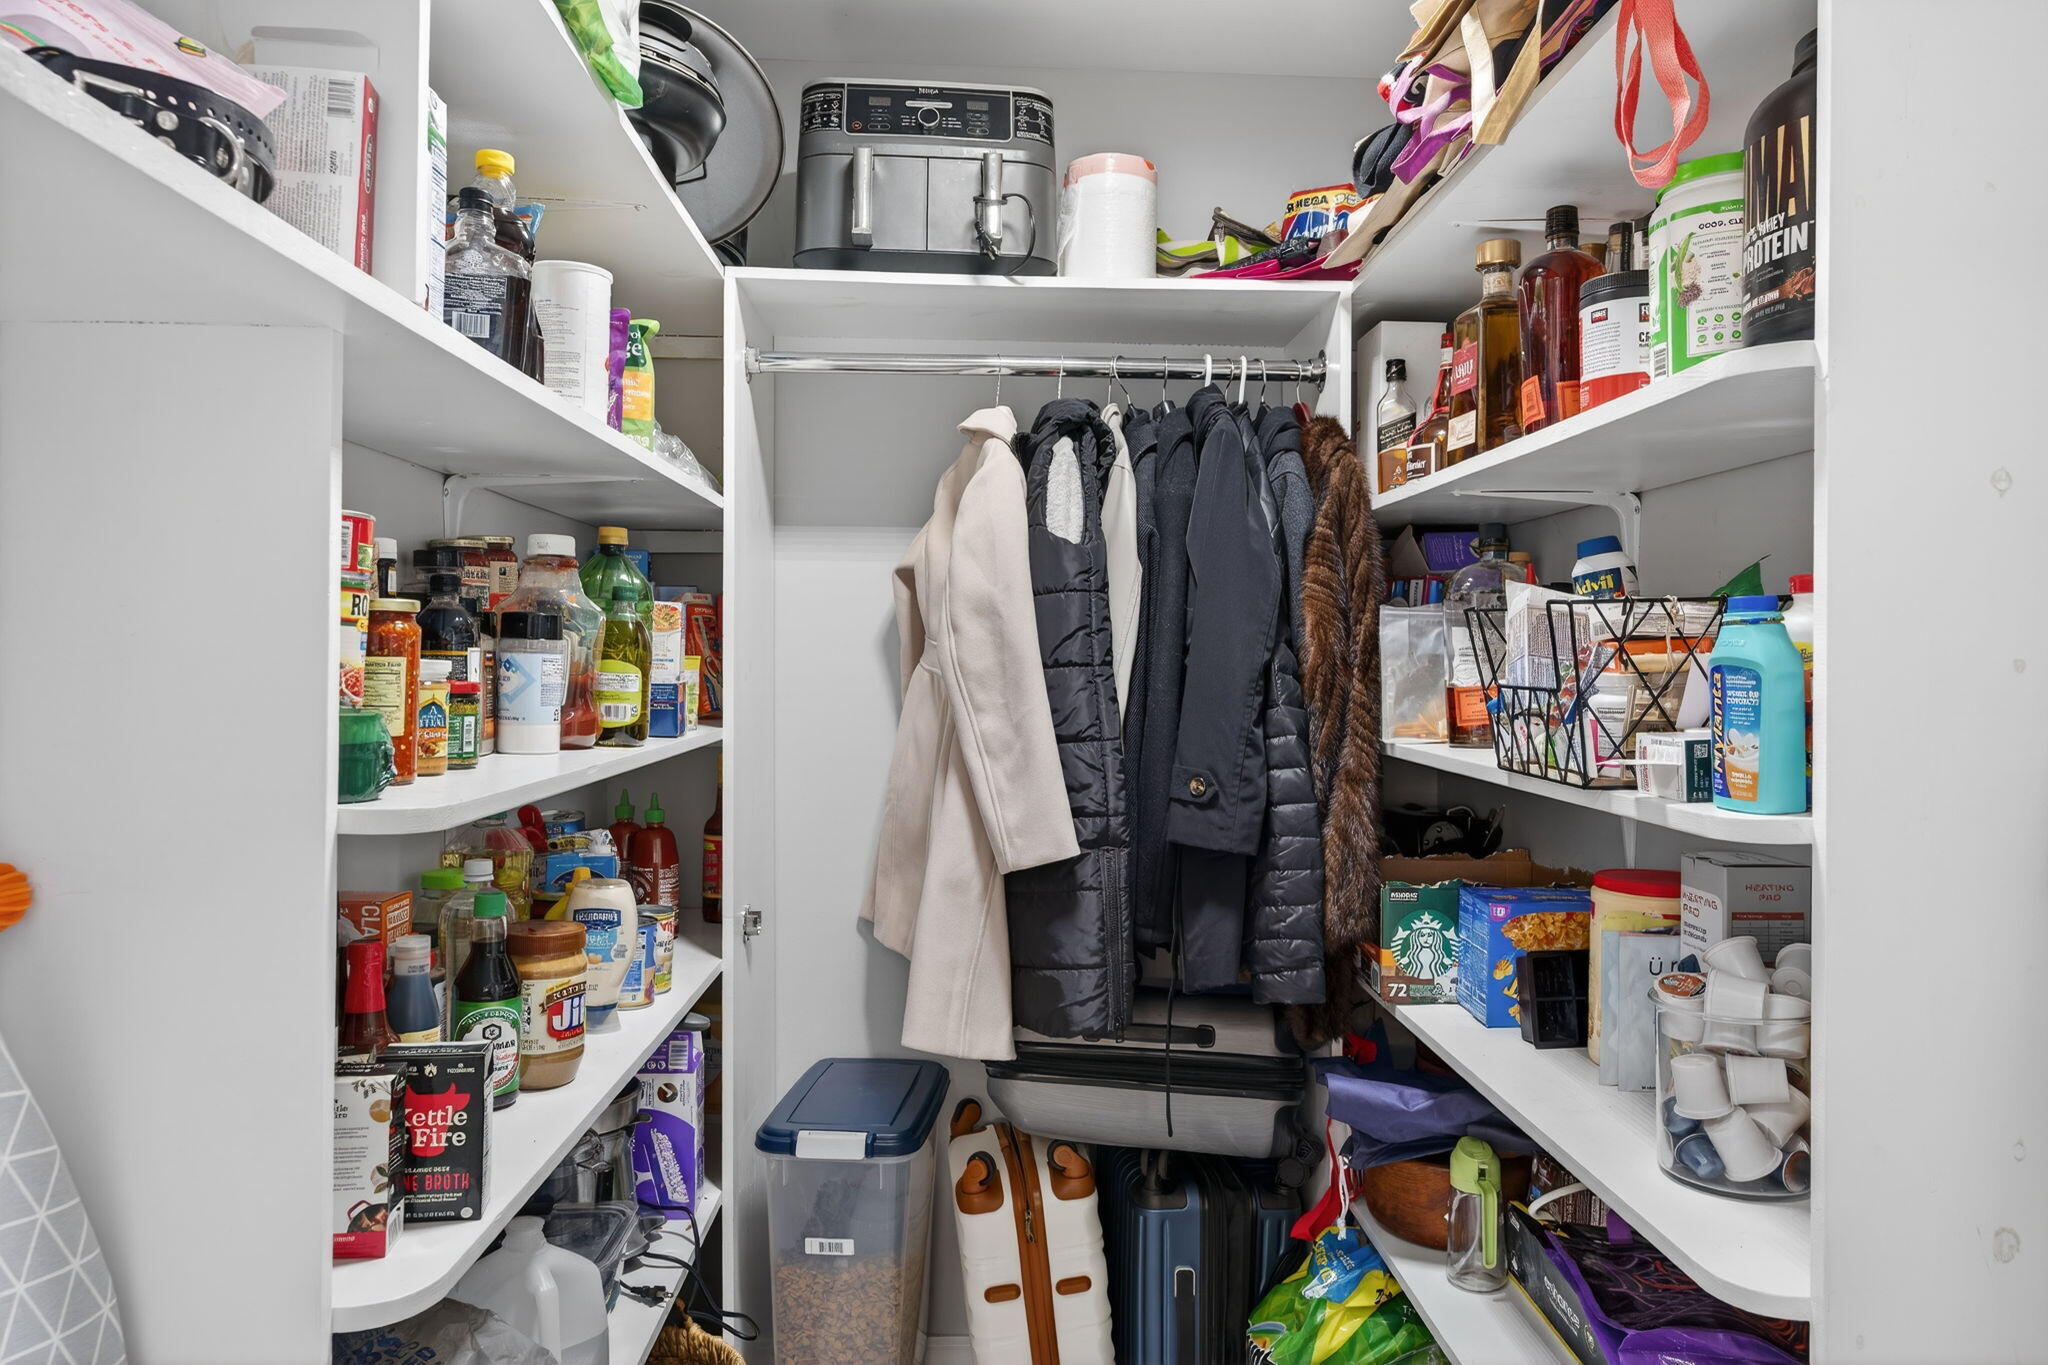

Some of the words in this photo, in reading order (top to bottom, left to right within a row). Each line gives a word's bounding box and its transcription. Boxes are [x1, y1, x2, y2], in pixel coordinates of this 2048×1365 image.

[1575, 574, 1614, 595] Advil
[1713, 671, 1725, 774] Mylanta
[1745, 883, 1795, 892] HEATING
[1387, 983, 1408, 998] 72
[404, 1105, 468, 1127] Kettle
[415, 1128, 467, 1147] Fire
[425, 1172, 471, 1190] BROTH
